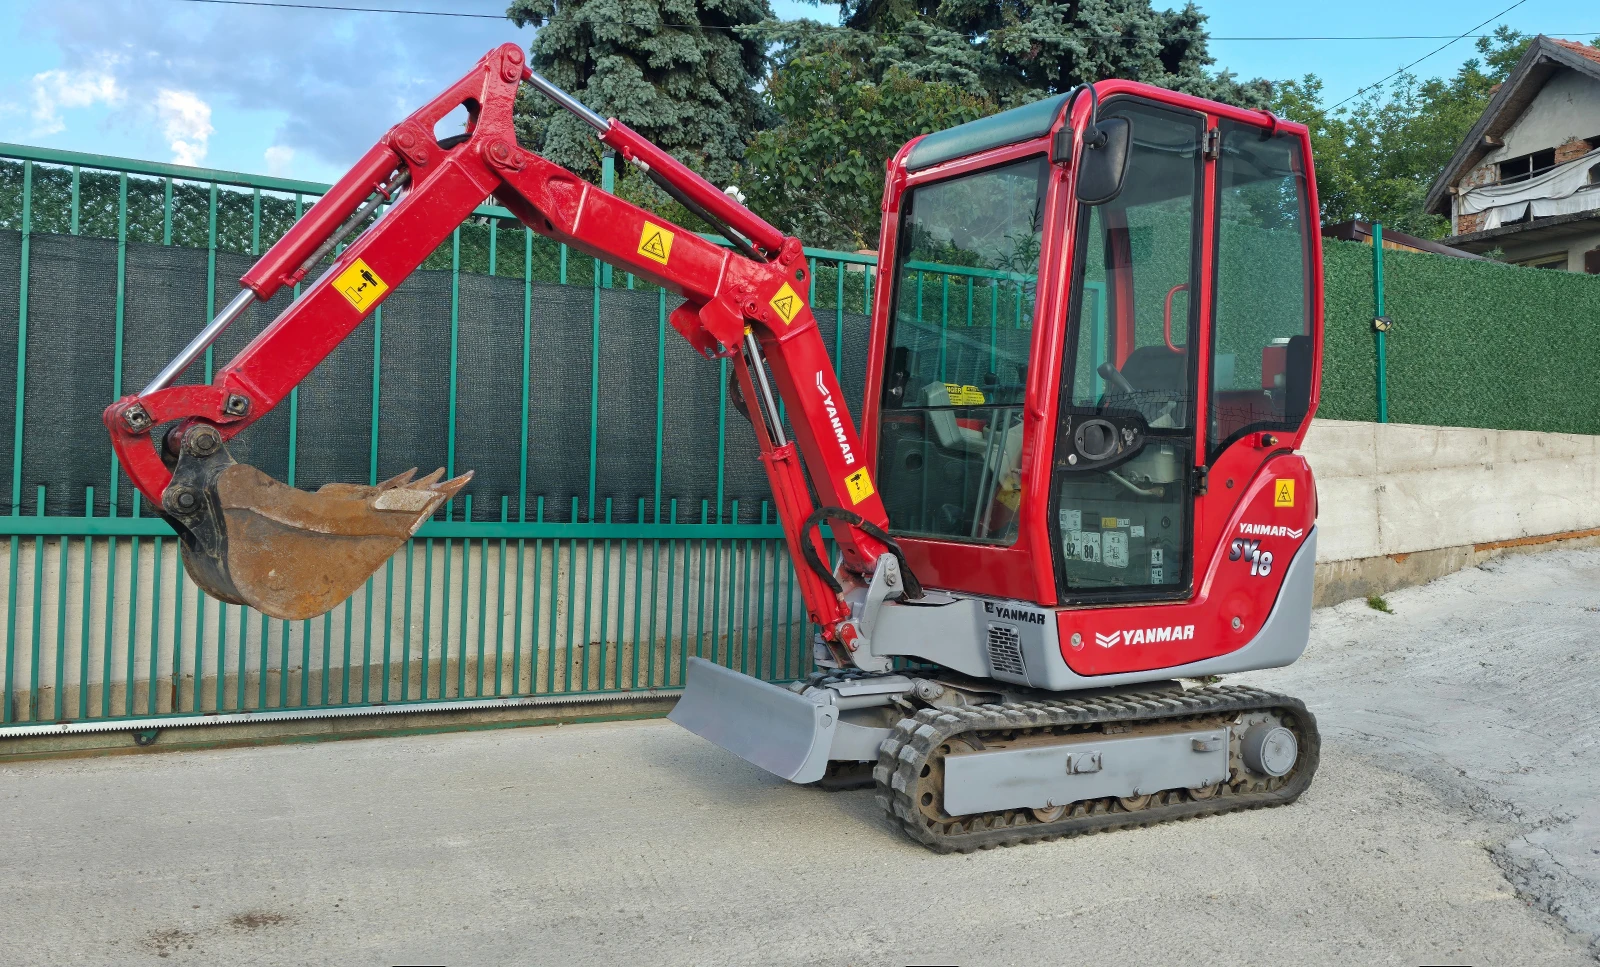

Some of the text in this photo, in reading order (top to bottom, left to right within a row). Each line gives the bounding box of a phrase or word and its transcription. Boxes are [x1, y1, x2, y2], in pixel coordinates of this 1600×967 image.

[823, 395, 855, 464] YANMAR
[1239, 522, 1287, 537] YANMAR
[995, 606, 1046, 625] YANMAR
[1122, 625, 1195, 646] YANMAR
